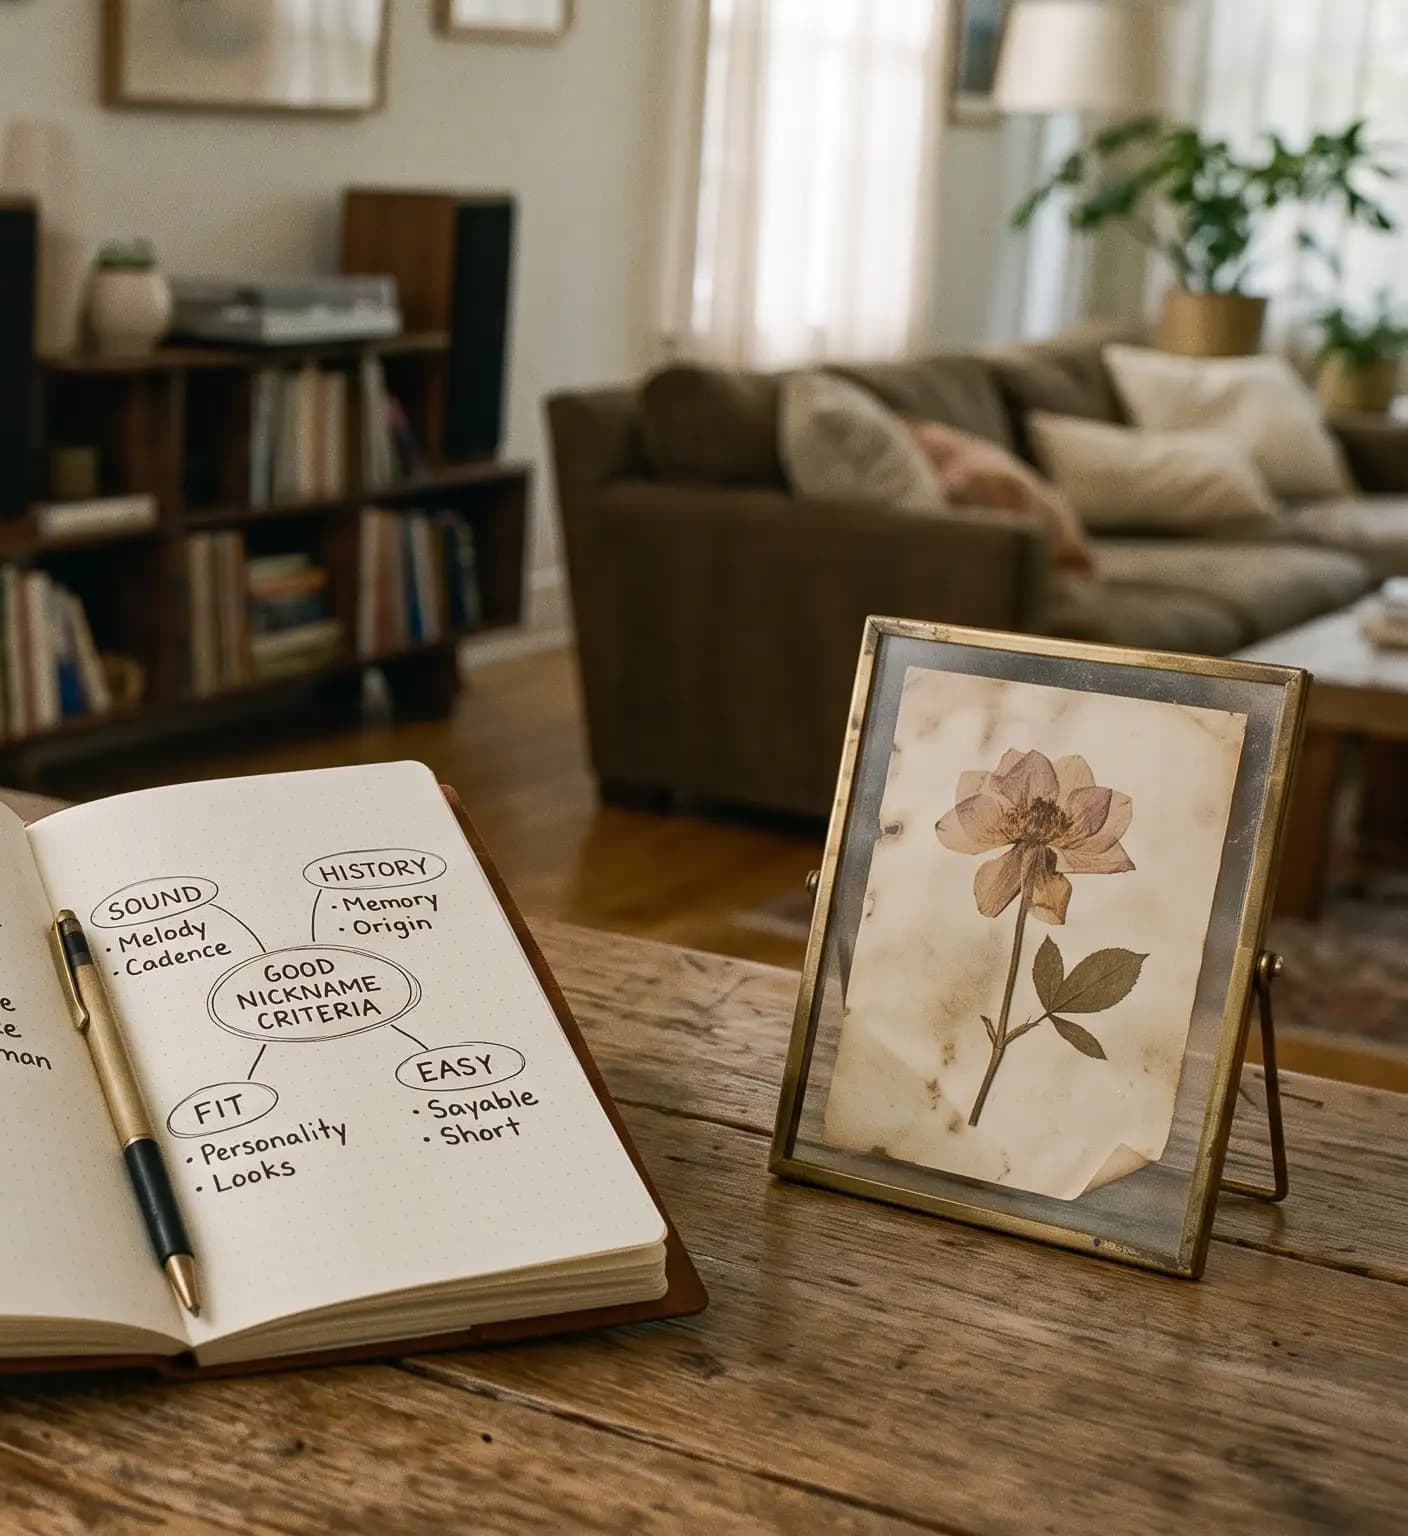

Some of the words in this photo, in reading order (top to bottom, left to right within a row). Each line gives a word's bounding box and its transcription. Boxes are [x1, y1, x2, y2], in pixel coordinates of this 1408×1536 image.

[318, 856, 427, 883] HISTORY
[108, 885, 202, 921] SOUND
[342, 894, 438, 912] Memory
[118, 919, 206, 954] Melody
[352, 916, 433, 940] Origin
[125, 942, 232, 976] Cadence
[263, 958, 335, 983] GOOD
[235, 975, 382, 1011] NICKNAME
[257, 998, 382, 1030] CRITERIA
[415, 1053, 493, 1083] EASY
[193, 1093, 243, 1125] FIT
[427, 1089, 540, 1121] Sayable
[199, 1117, 346, 1166] Personality
[439, 1116, 521, 1146] Short
[212, 1160, 296, 1193] Looks
